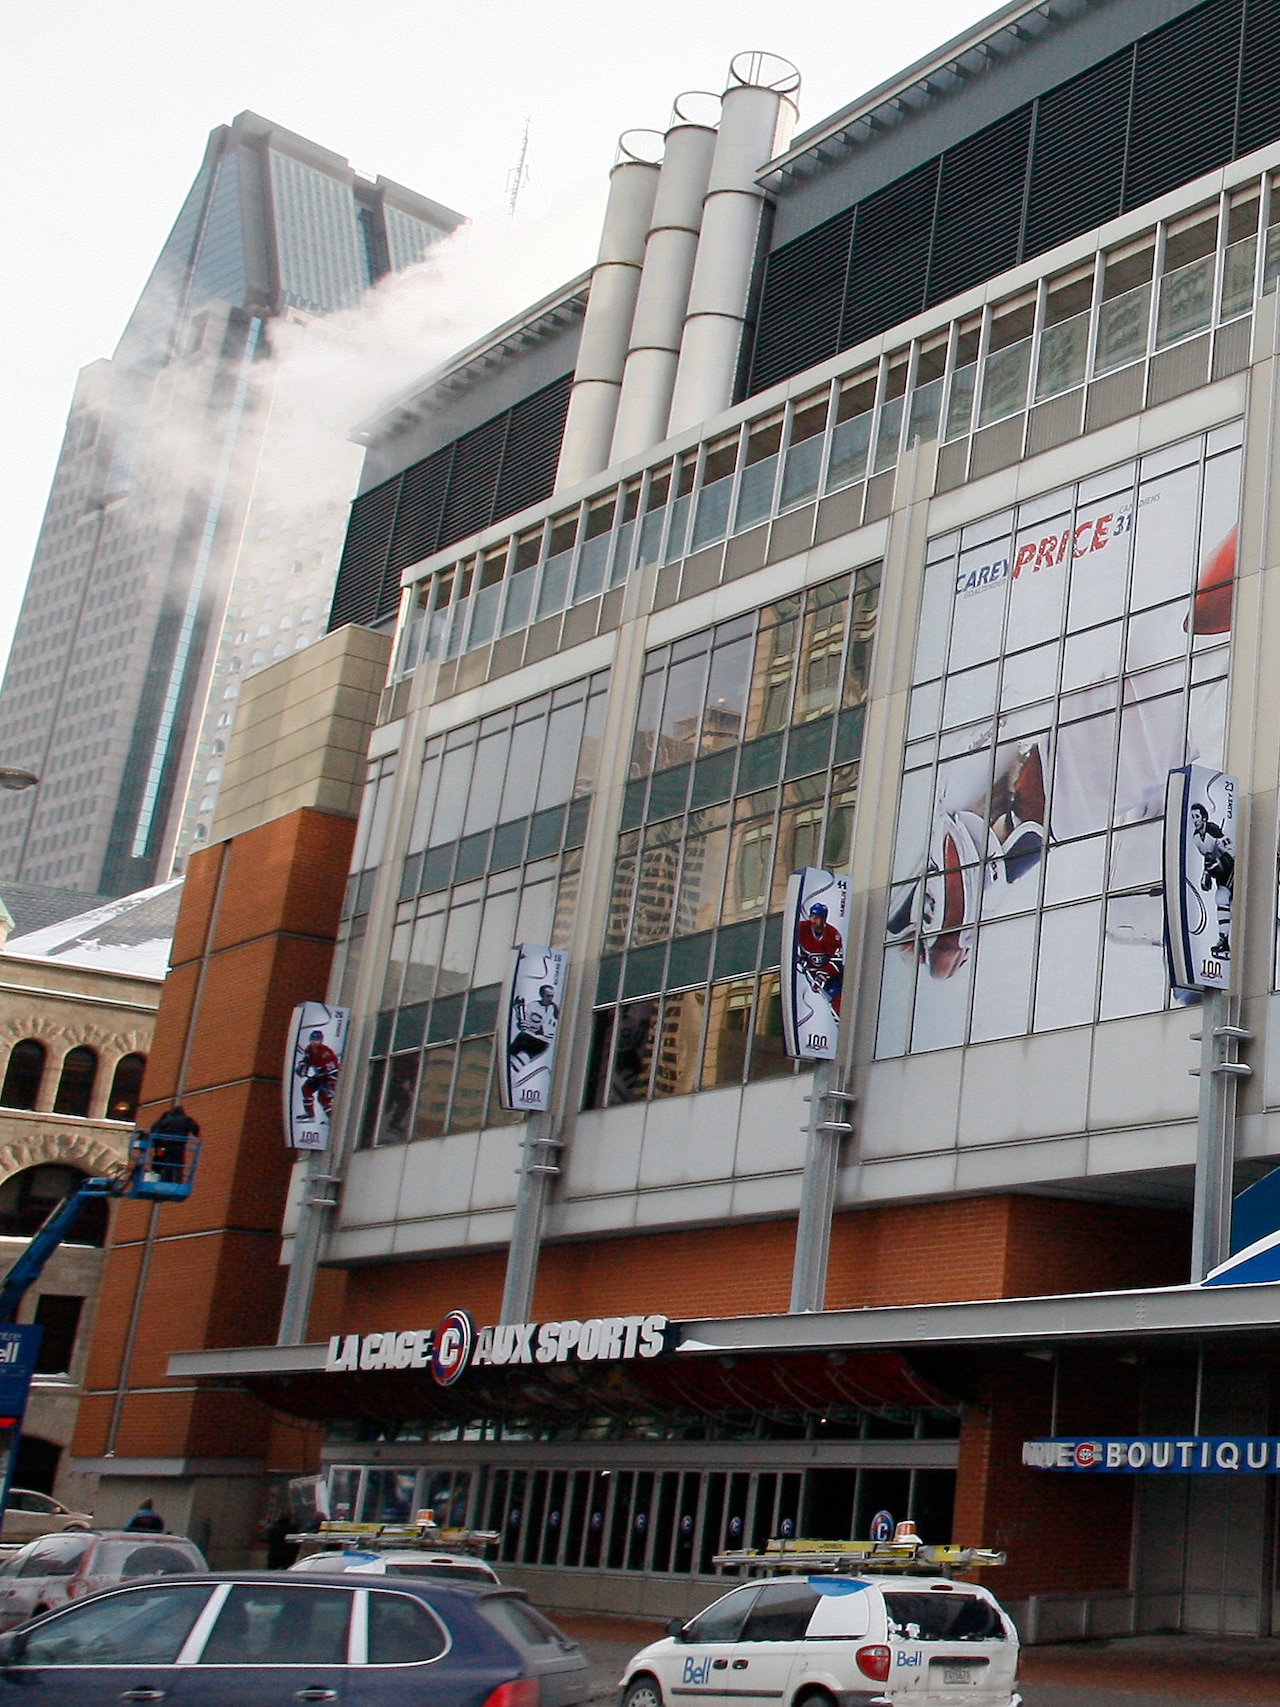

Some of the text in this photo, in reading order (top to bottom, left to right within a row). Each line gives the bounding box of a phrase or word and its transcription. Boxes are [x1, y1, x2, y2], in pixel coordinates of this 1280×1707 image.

[955, 513, 1132, 595] CAREY PRICE 31
[1201, 959, 1221, 975] 100
[808, 1033, 827, 1049] 100
[325, 1334, 359, 1372] LA
[360, 1329, 434, 1370] CAGE
[471, 1322, 538, 1366] AUX
[537, 1314, 669, 1364] SPORTS
[896, 1650, 922, 1667] Bell
[683, 1656, 712, 1684] Bell
